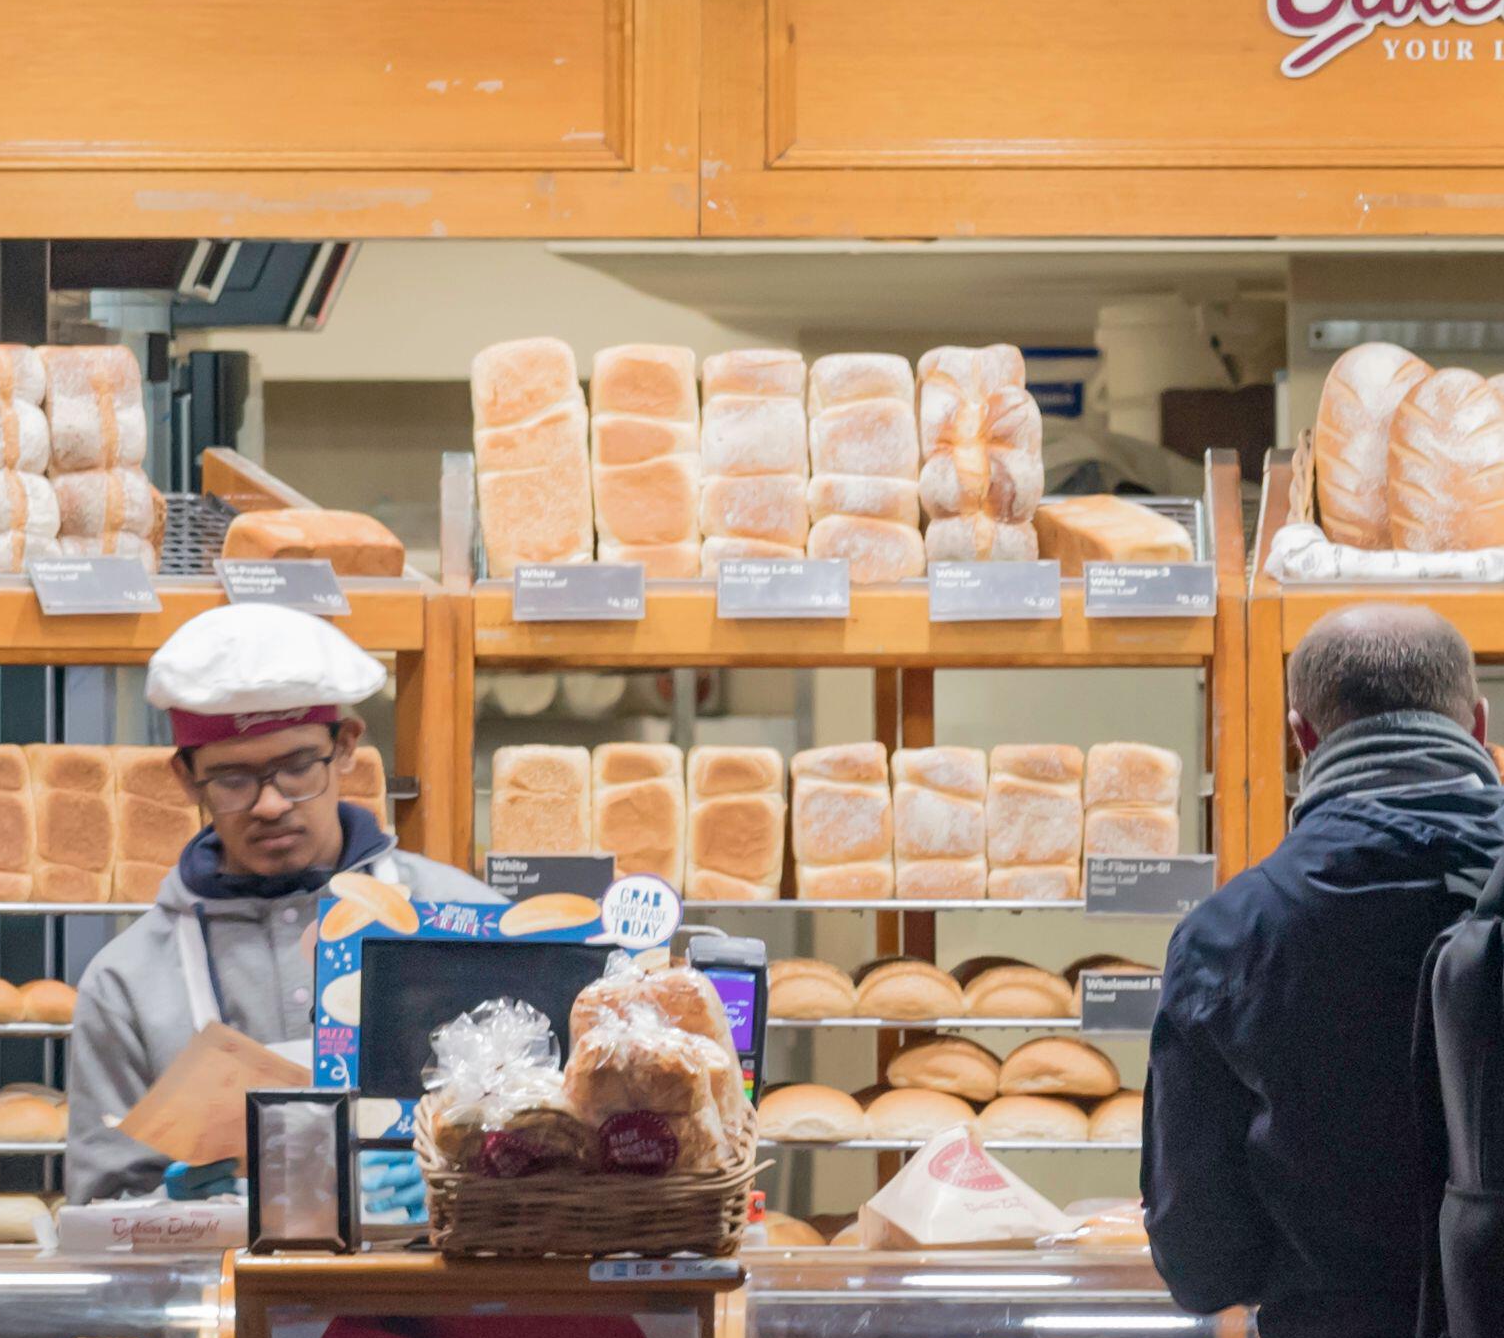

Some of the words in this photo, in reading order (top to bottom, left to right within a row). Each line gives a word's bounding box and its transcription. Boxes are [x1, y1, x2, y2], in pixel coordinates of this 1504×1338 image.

[1382, 39, 1475, 61] YOUR
[33, 563, 92, 572] Wholemeal
[936, 568, 972, 579] White
[520, 569, 557, 579] White
[1090, 578, 1126, 587] White
[492, 860, 528, 872] White
[620, 888, 661, 906] GRAB
[610, 906, 639, 919] YOUR
[614, 920, 662, 939] TODAY
[1086, 978, 1150, 990] Wholemeal
[168, 1218, 220, 1238] Delight
